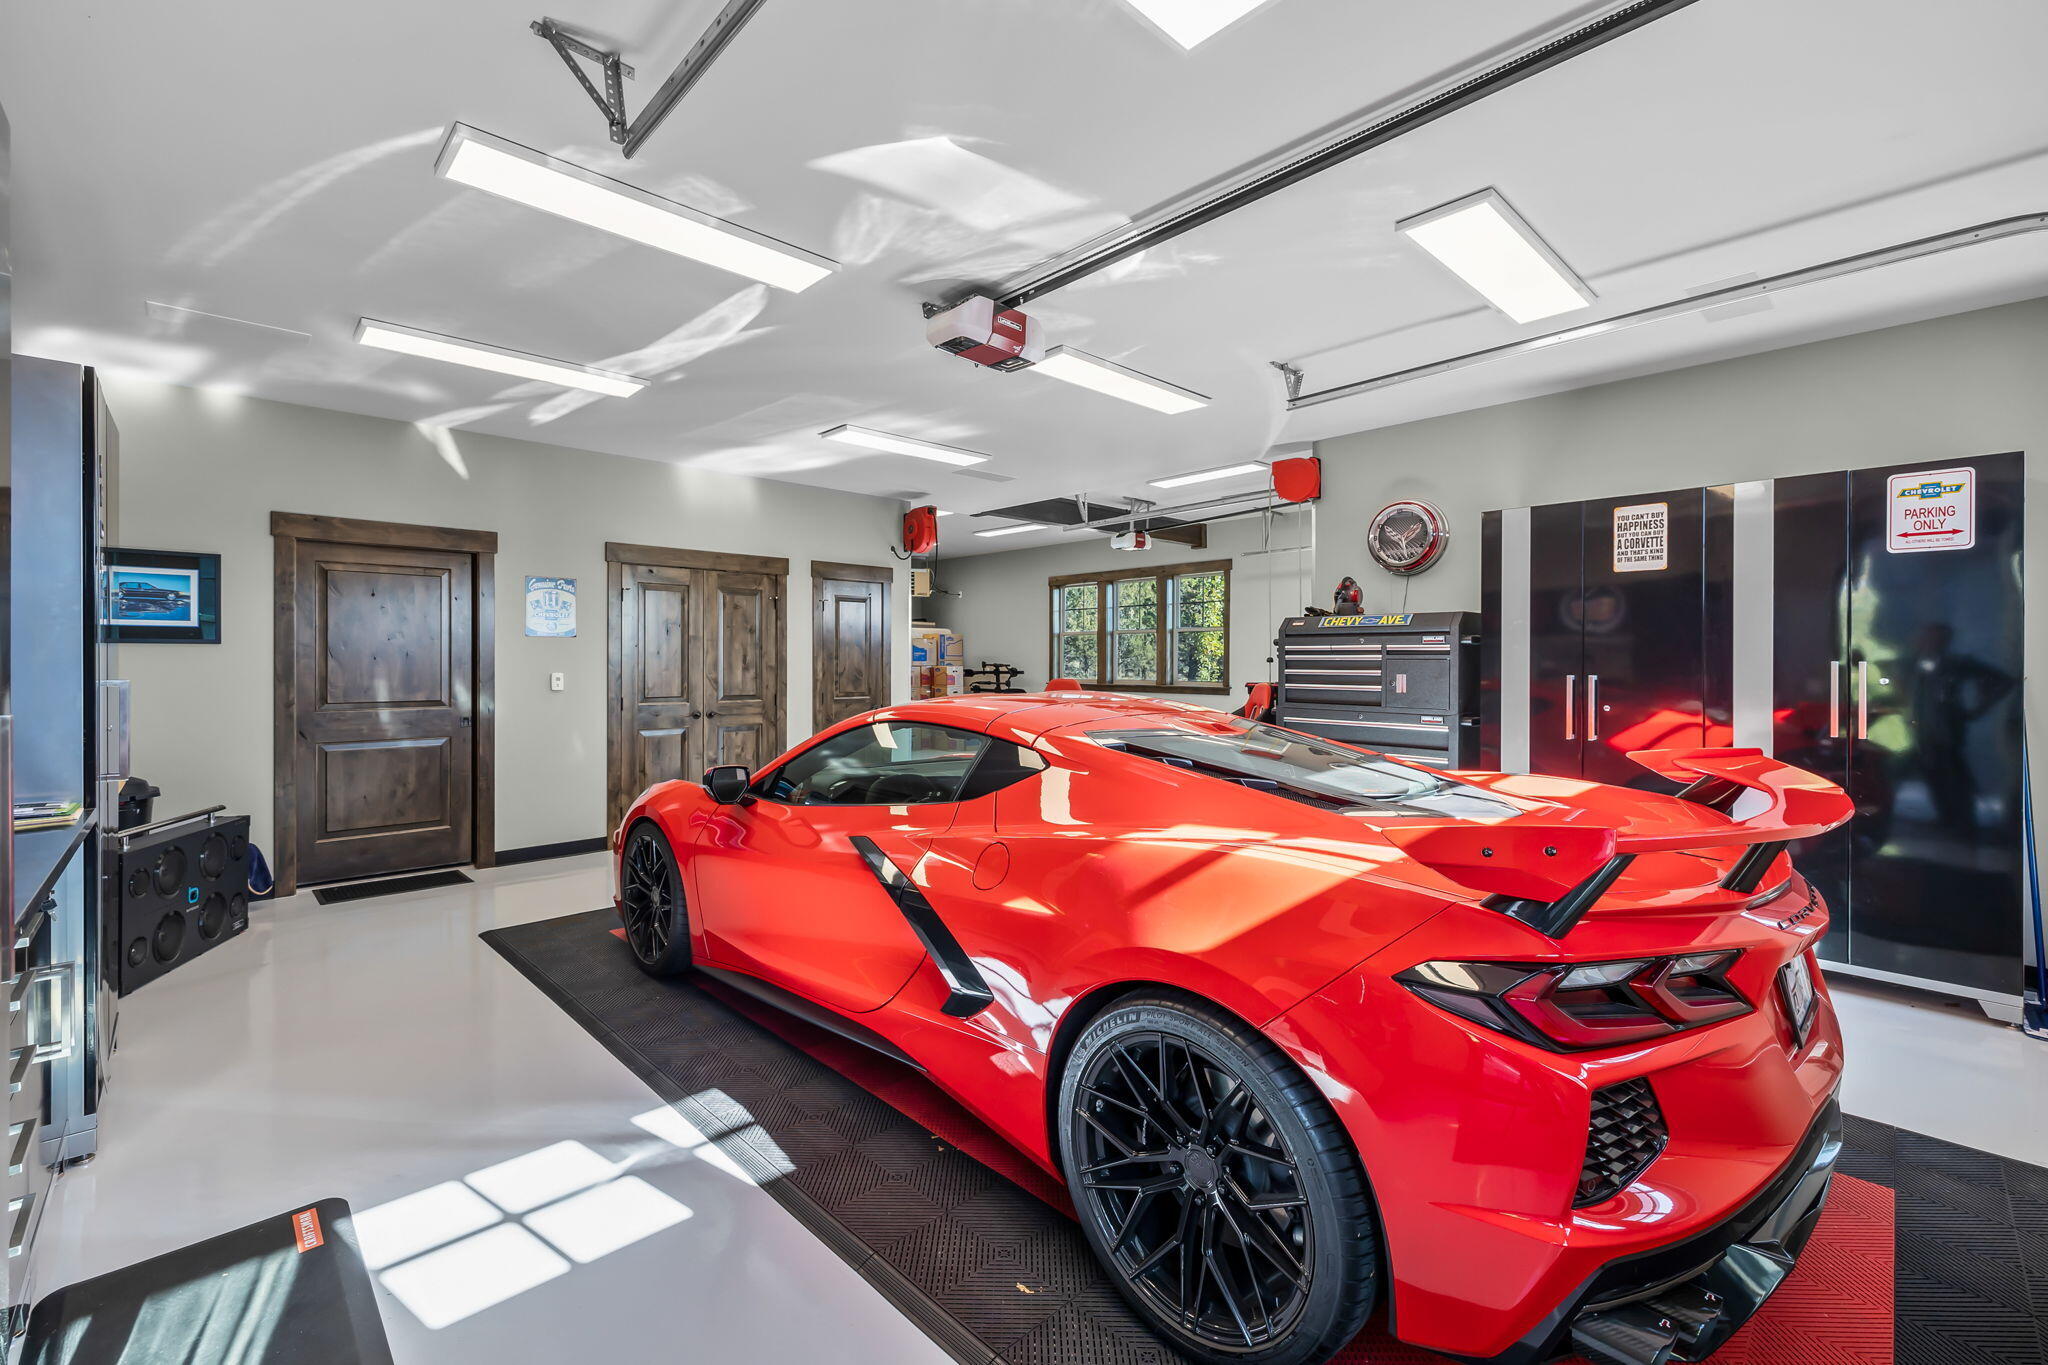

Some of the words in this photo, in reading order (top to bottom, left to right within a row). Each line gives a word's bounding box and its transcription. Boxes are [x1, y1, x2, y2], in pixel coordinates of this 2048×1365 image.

[1904, 486, 1957, 496] CHEVROLET
[1651, 511, 1664, 519] BUY
[1904, 505, 1956, 520] PARKING
[1617, 519, 1664, 532] HAPPINESS
[1913, 518, 1946, 531] ONLY
[1617, 539, 1622, 550] A
[1624, 536, 1664, 549] CORVETTE
[1324, 616, 1362, 627] CHEVY
[1085, 1012, 1137, 1048] MICHELIN
[1146, 1011, 1166, 1019] PILOT
[1170, 1016, 1194, 1029] SPORT
